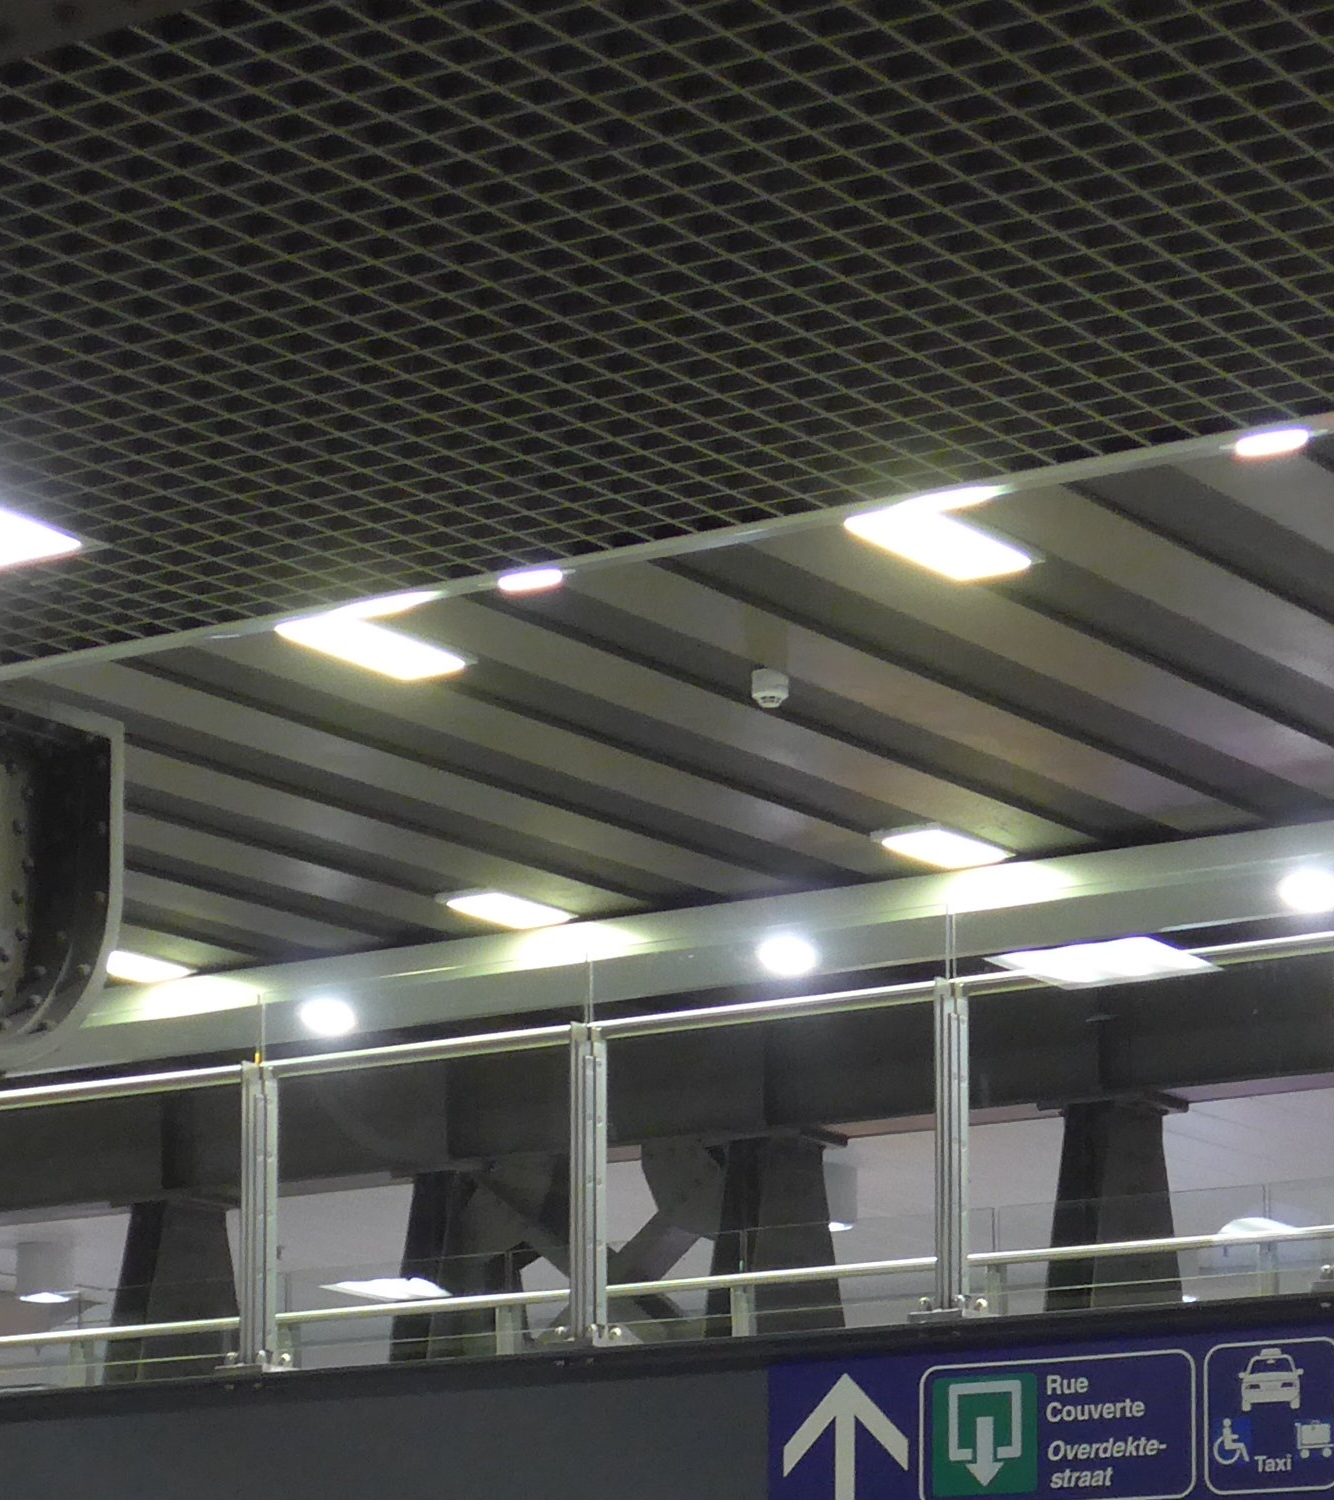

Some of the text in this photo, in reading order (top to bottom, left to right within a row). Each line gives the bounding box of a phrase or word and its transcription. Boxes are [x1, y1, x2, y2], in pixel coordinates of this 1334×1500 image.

[1046, 1374, 1089, 1395] Rue
[1046, 1398, 1145, 1422] Couverte
[1047, 1436, 1167, 1461] Overdekte-
[1254, 1453, 1292, 1473] Taxi
[1050, 1466, 1113, 1489] straat
